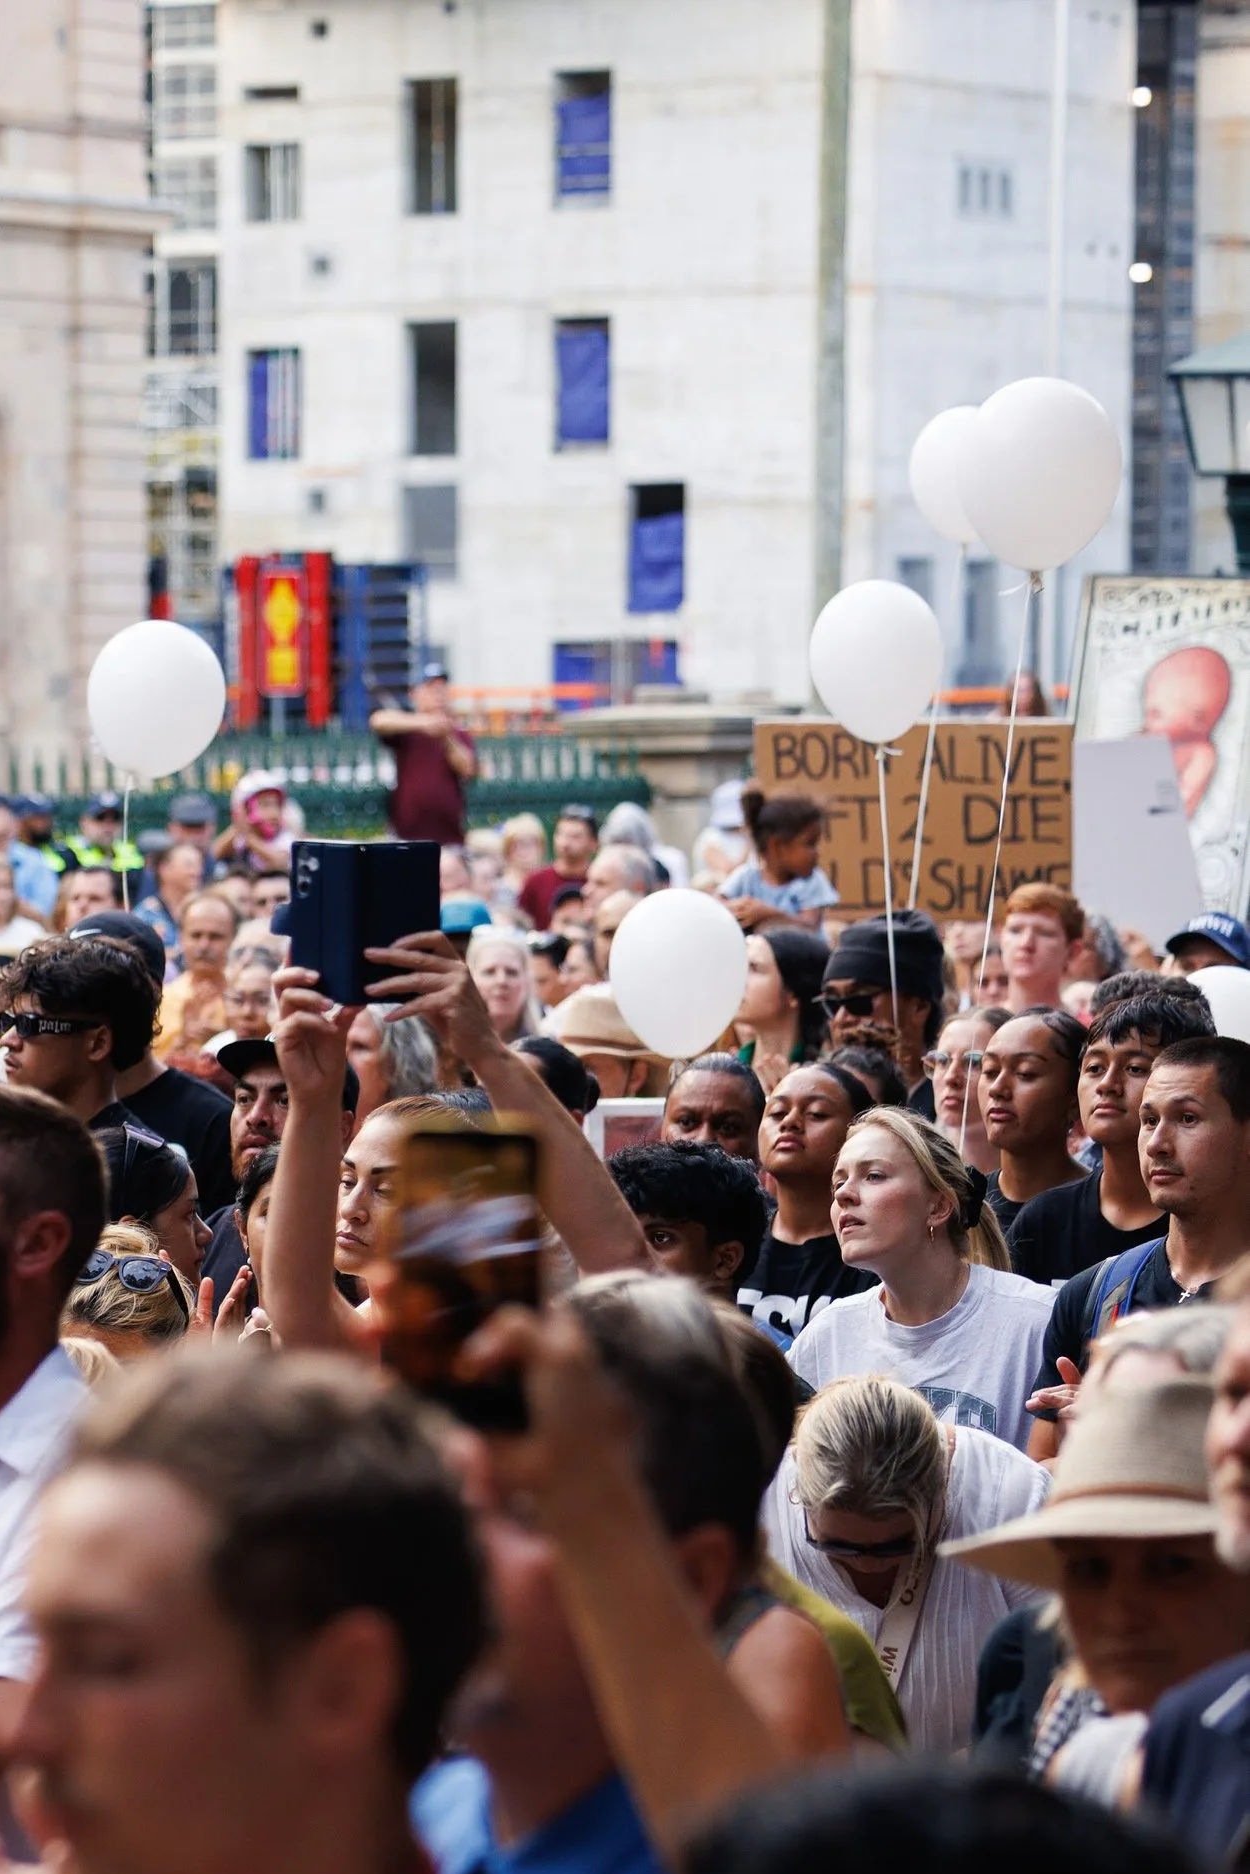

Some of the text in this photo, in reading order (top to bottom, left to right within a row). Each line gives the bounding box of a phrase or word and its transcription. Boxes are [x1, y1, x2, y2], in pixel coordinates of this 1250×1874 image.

[772, 731, 892, 781] BORN
[899, 795, 934, 846] 2
[962, 795, 1063, 845] DIE
